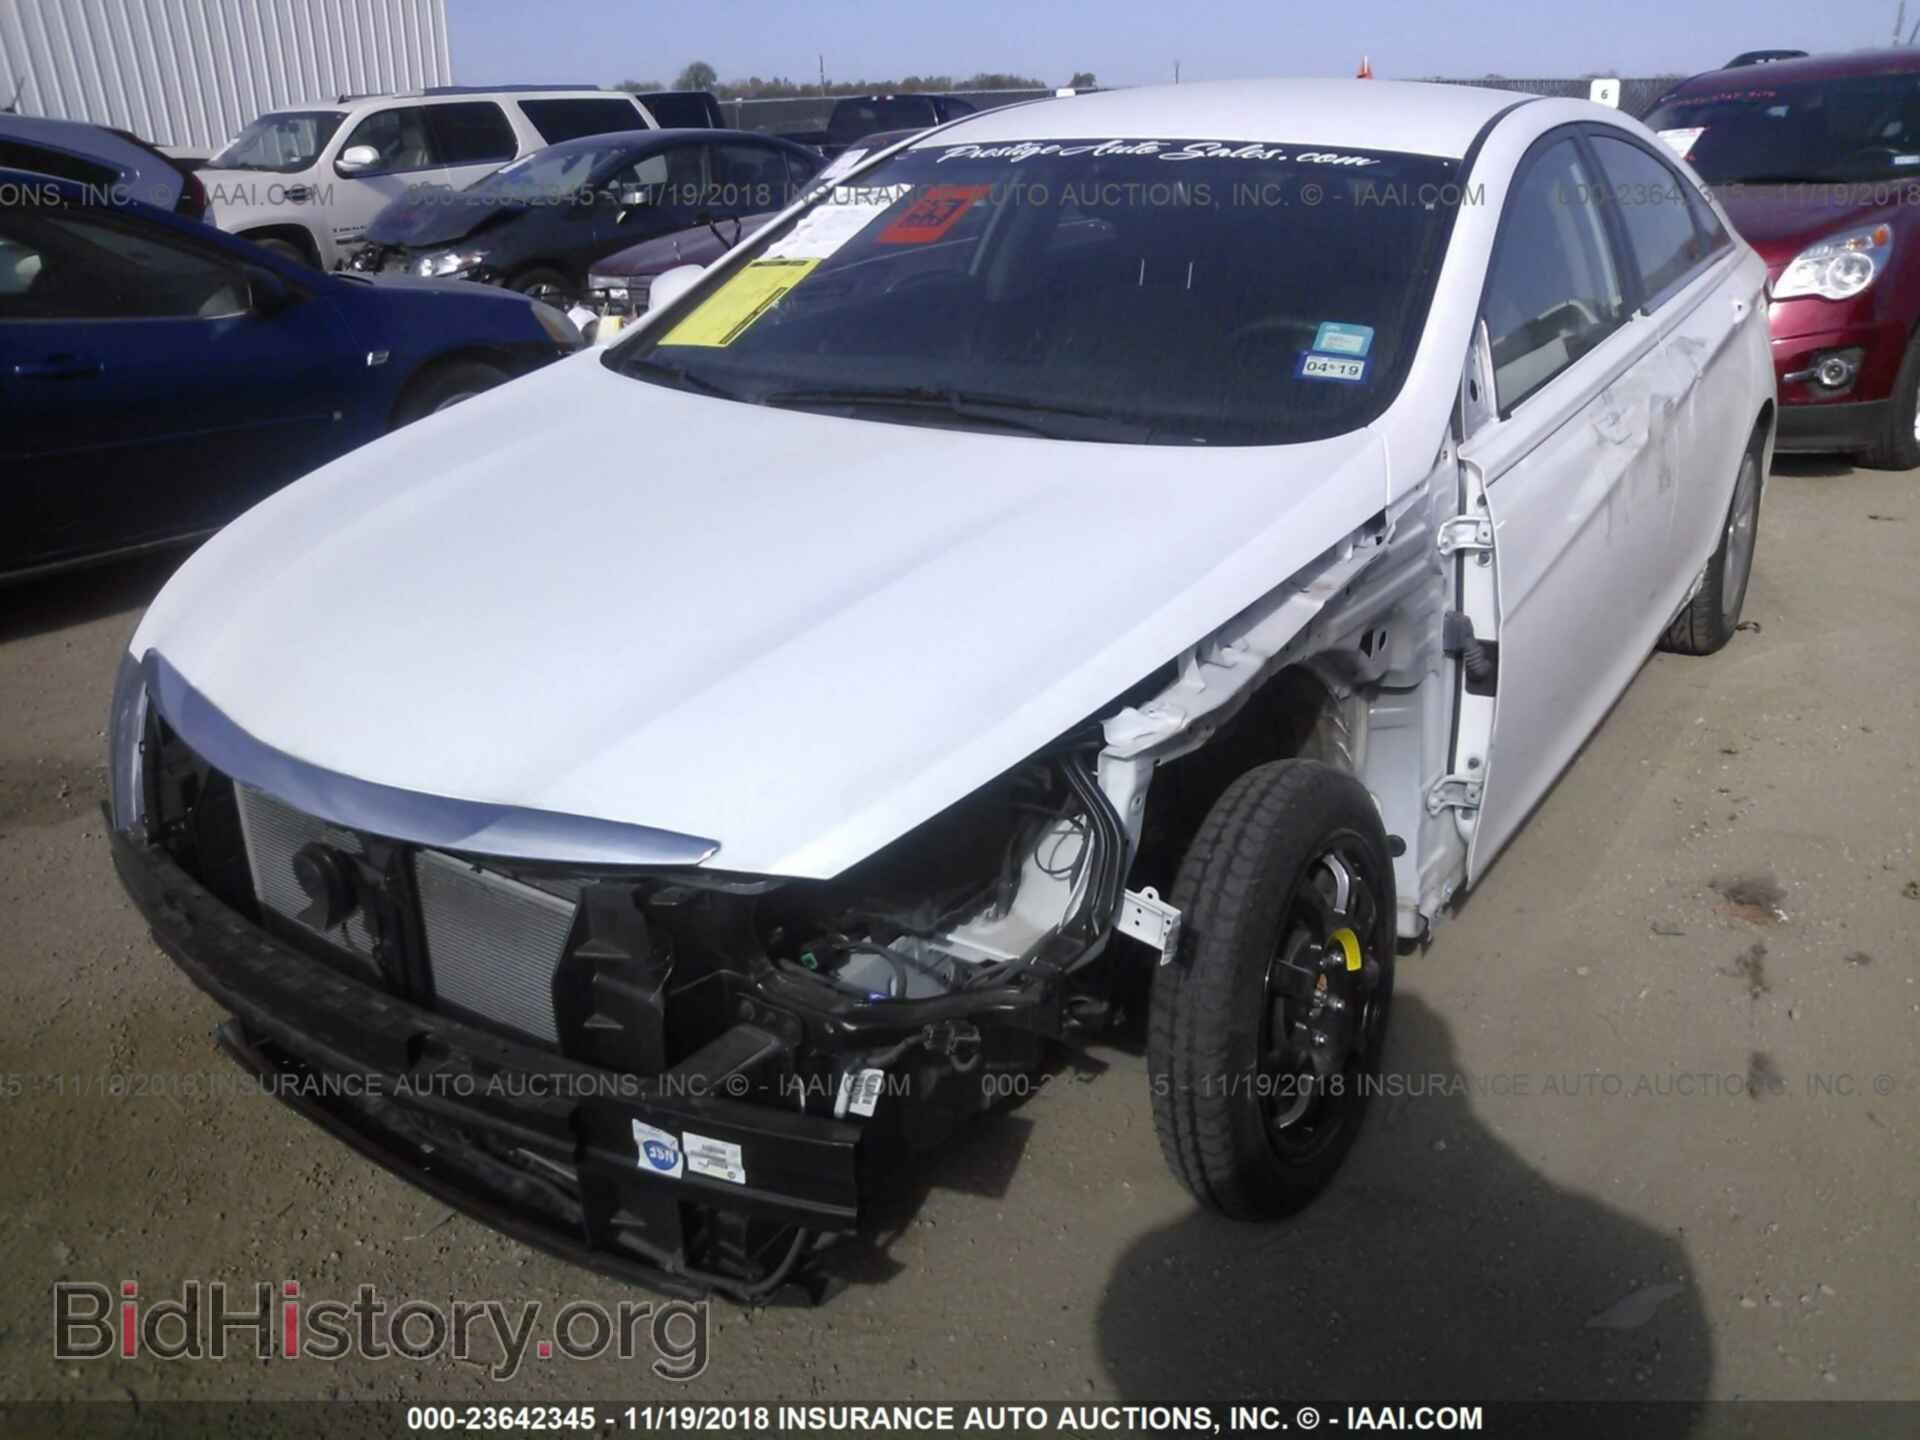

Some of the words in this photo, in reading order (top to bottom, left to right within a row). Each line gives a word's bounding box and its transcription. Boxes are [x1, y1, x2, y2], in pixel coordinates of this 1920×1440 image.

[1600, 88, 1609, 100] 6
[936, 142, 1062, 164] Prestige
[1059, 139, 1171, 157] Auto
